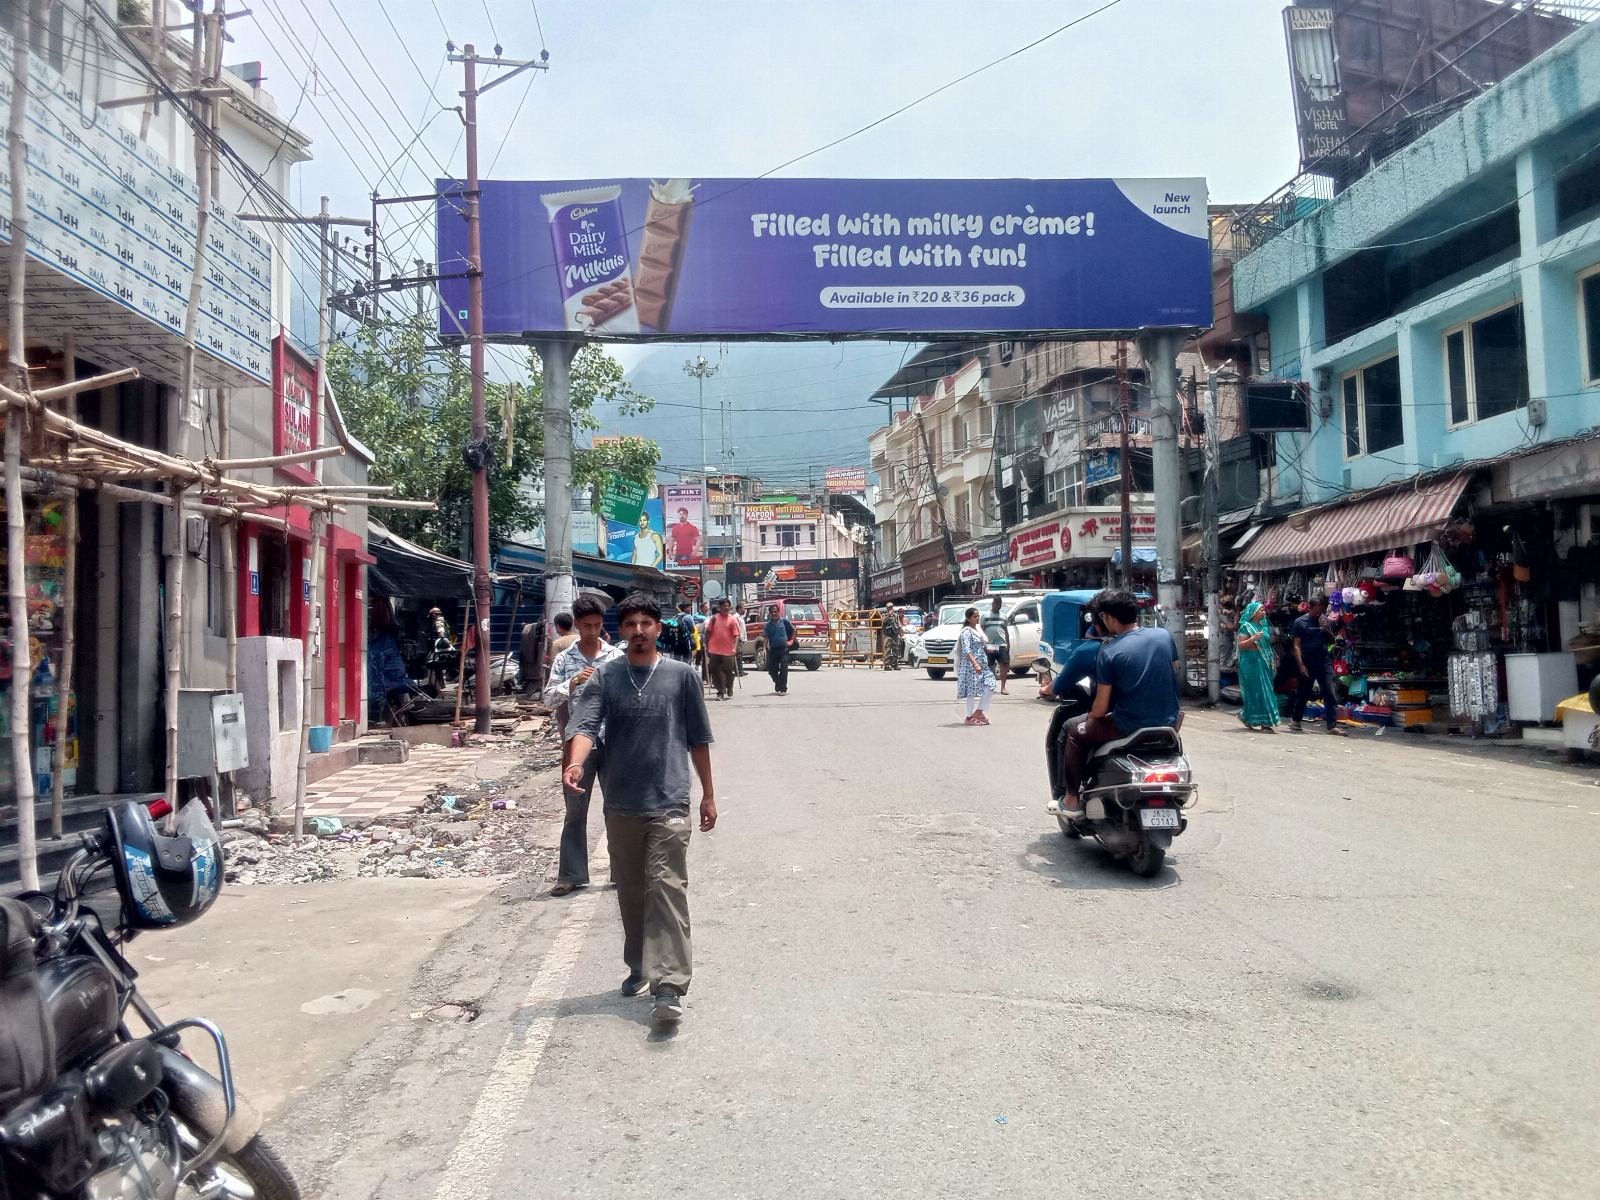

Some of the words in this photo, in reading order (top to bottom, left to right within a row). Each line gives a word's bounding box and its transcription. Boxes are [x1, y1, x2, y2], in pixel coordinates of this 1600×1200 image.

[1292, 10, 1332, 22] LUXMI
[1304, 108, 1346, 121] VISHAL
[1314, 121, 1338, 130] HOTEL
[118, 127, 136, 150] HPL
[57, 165, 79, 189] HPL
[117, 166, 135, 188] HPL
[168, 167, 183, 188] HPL
[1164, 192, 1191, 203] New
[56, 207, 78, 230] HPL
[116, 205, 134, 225] HPL
[167, 202, 183, 222] HPL
[210, 200, 224, 220] HPL
[1153, 204, 1191, 215] launch
[751, 214, 830, 237] Filled
[837, 213, 901, 236] with
[908, 214, 983, 239] milky
[210, 234, 224, 252] HPL
[248, 231, 260, 248] HPL
[570, 231, 605, 245] Dairy
[115, 243, 133, 263] HPL
[166, 238, 182, 257] HPL
[573, 245, 604, 257] Milk
[813, 245, 892, 268] Filled
[899, 244, 962, 266] with
[968, 243, 1027, 268] fun!
[209, 268, 223, 285] HPL
[247, 262, 259, 279] HPL
[565, 255, 624, 288] Milkinis
[114, 282, 132, 302] HPL
[165, 274, 181, 293] HPL
[830, 291, 894, 305] Available
[897, 292, 910, 303] in
[941, 290, 952, 303] &
[982, 290, 1016, 305] pack
[209, 301, 223, 318] HPL
[165, 310, 181, 328] HPL
[247, 324, 259, 341] HPL
[208, 334, 222, 351] HPL
[247, 356, 259, 371] HPL
[1043, 394, 1075, 424] VASU
